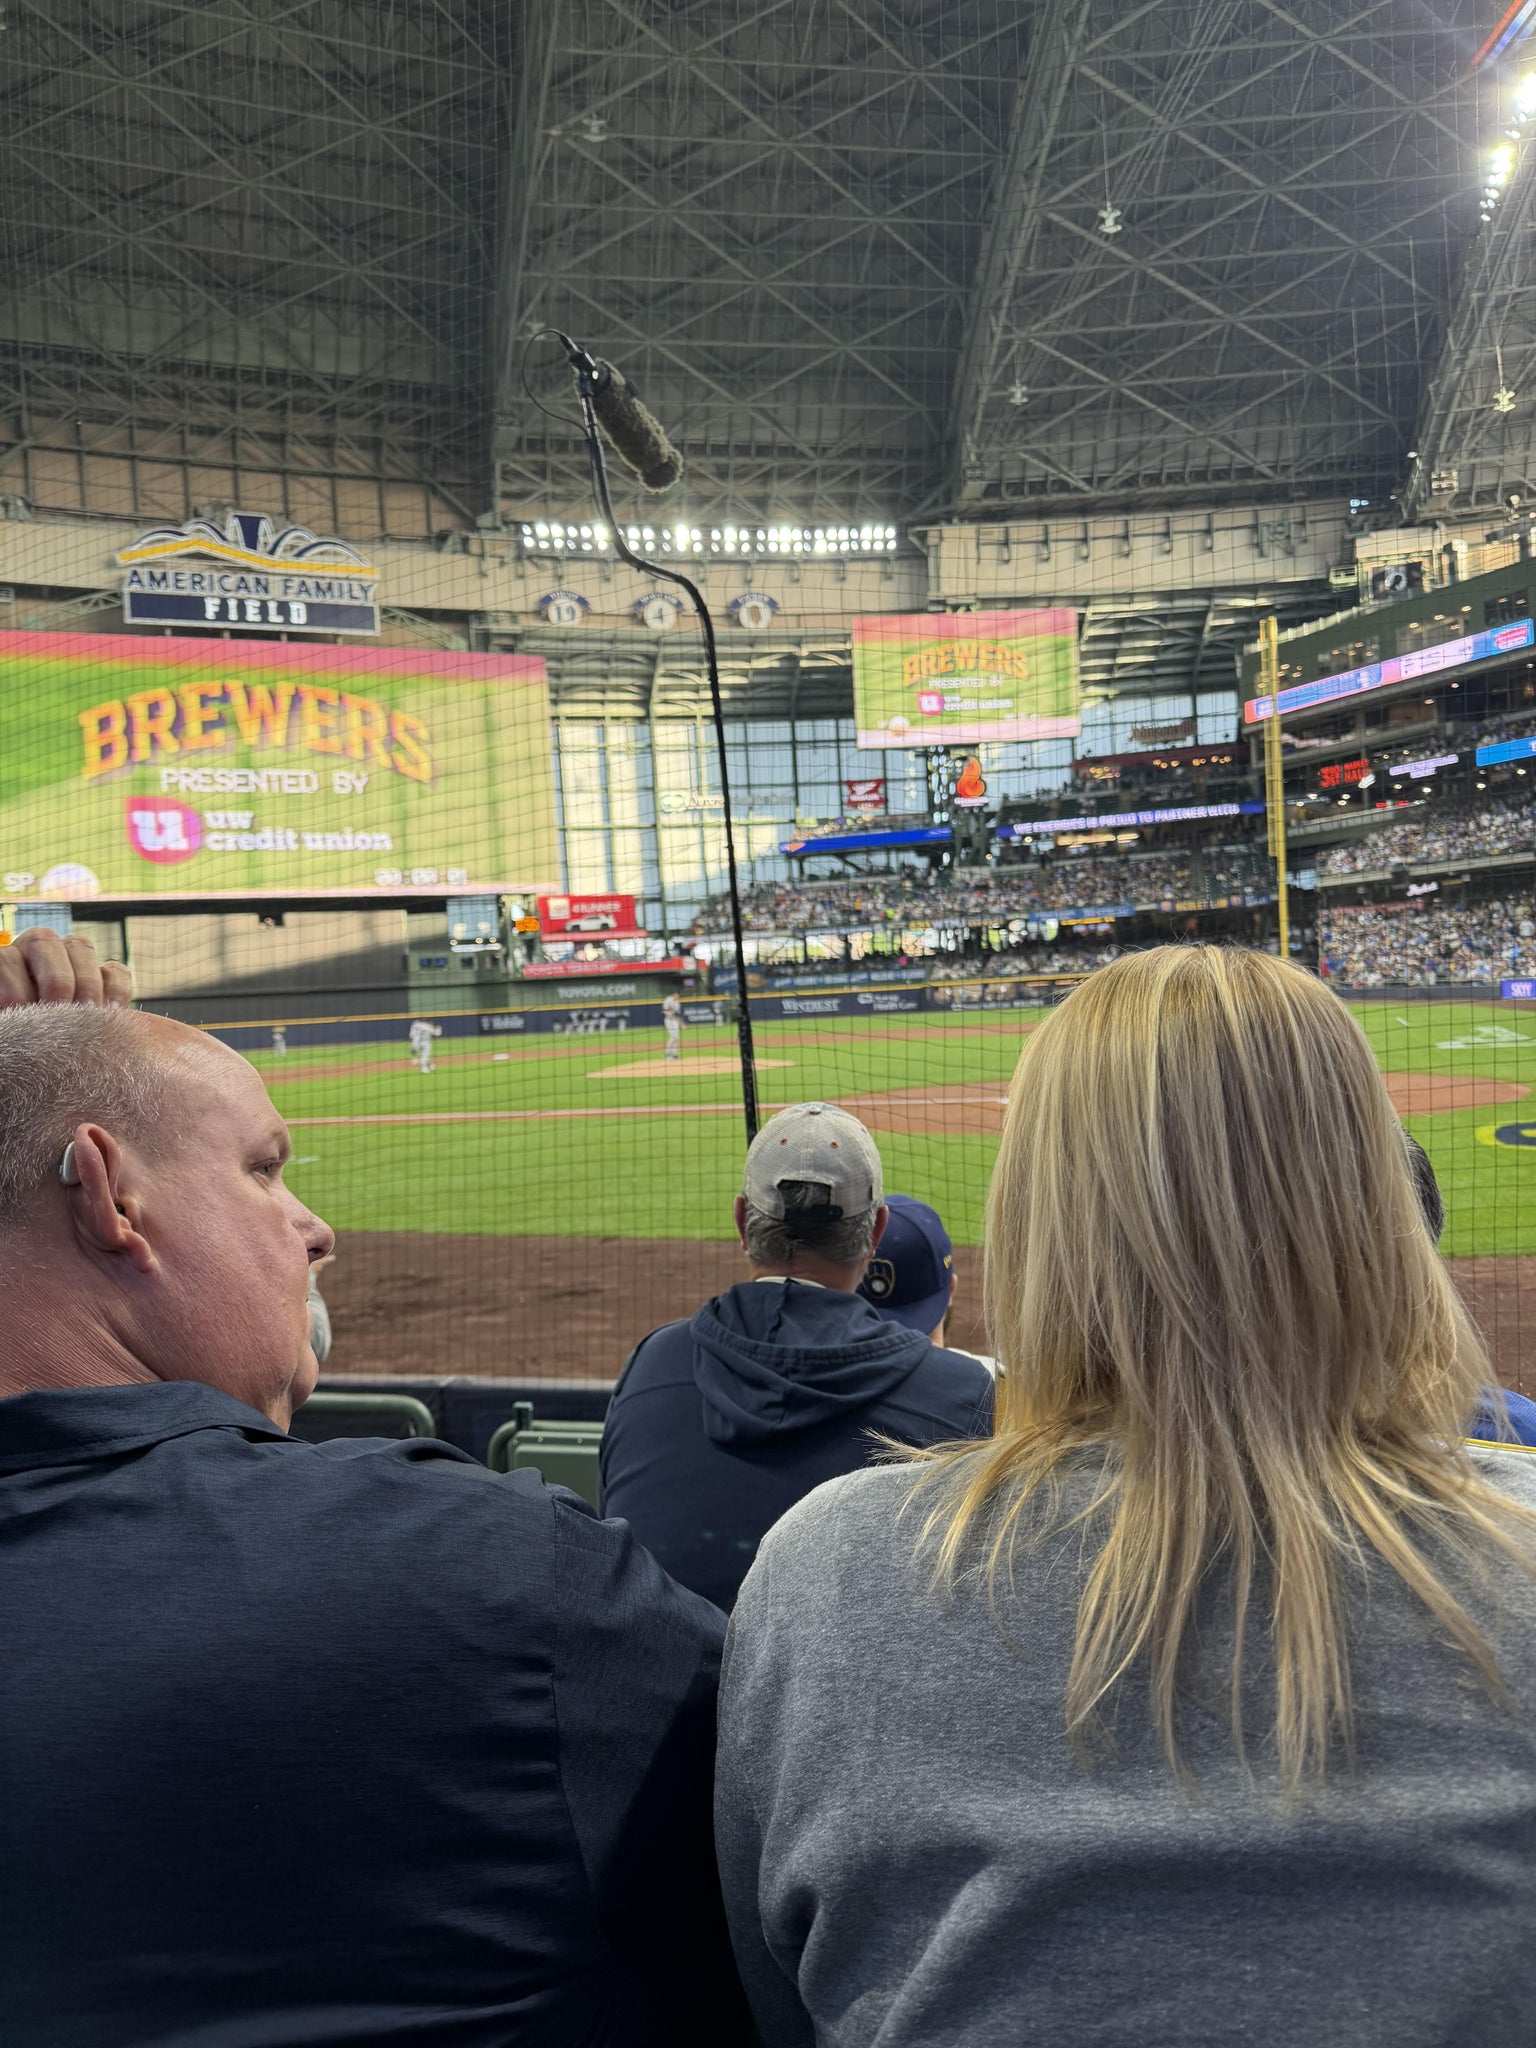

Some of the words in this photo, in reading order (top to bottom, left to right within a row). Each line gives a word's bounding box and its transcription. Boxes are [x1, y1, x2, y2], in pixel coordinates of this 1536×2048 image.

[128, 569, 269, 596] AMERICAN
[281, 577, 375, 601] FAMILY
[203, 597, 308, 625] FIELD
[902, 641, 1030, 688] BREWERS
[78, 679, 433, 784] BREWERS
[160, 768, 320, 794] PRESENTED
[332, 771, 370, 795] BY
[205, 811, 254, 829] uw
[1099, 812, 1138, 827] PROUD
[1139, 811, 1153, 823] TO
[1155, 806, 1207, 822] PARTNER
[205, 827, 299, 850] credit
[303, 827, 393, 851] union
[558, 983, 637, 999] TOYOTA.COM
[782, 998, 840, 1014] WINTRUST
